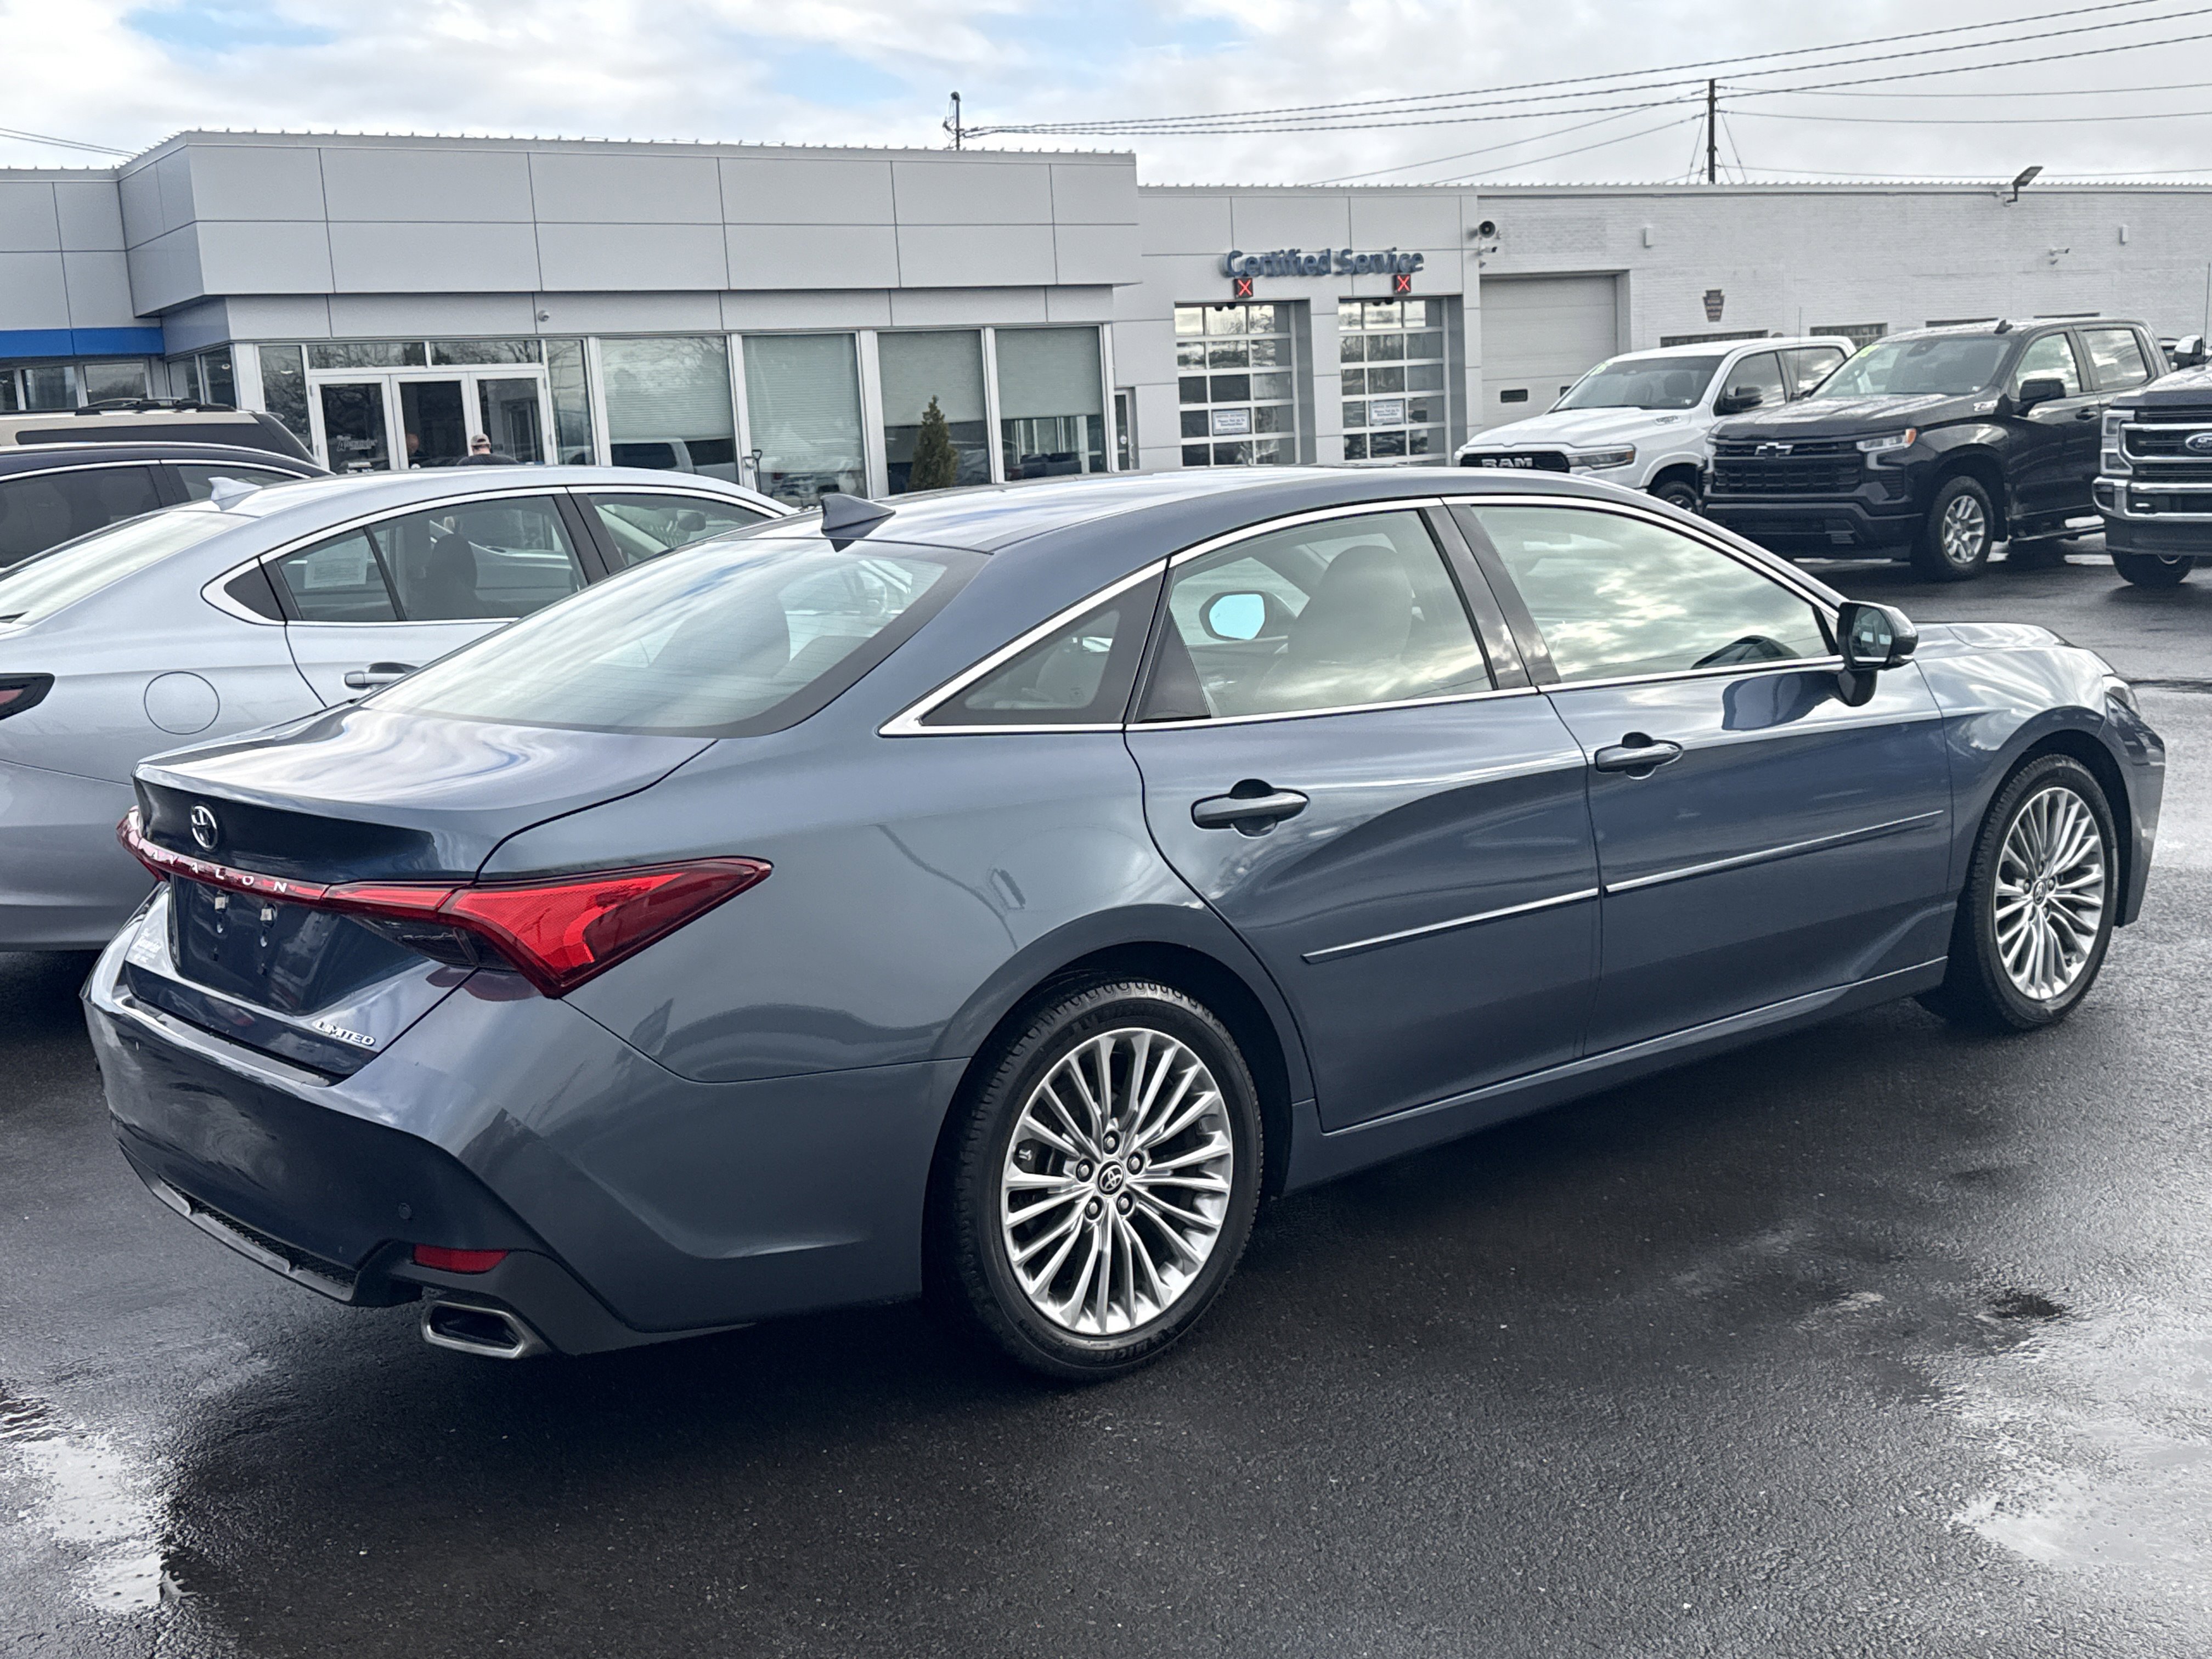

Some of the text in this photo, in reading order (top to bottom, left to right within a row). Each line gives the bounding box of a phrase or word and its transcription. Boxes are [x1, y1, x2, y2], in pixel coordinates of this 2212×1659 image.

[1226, 247, 1424, 276] Certified Service
[1481, 457, 1533, 467] RAM
[150, 849, 287, 893] AVALON
[315, 1021, 375, 1046] LIMITED
